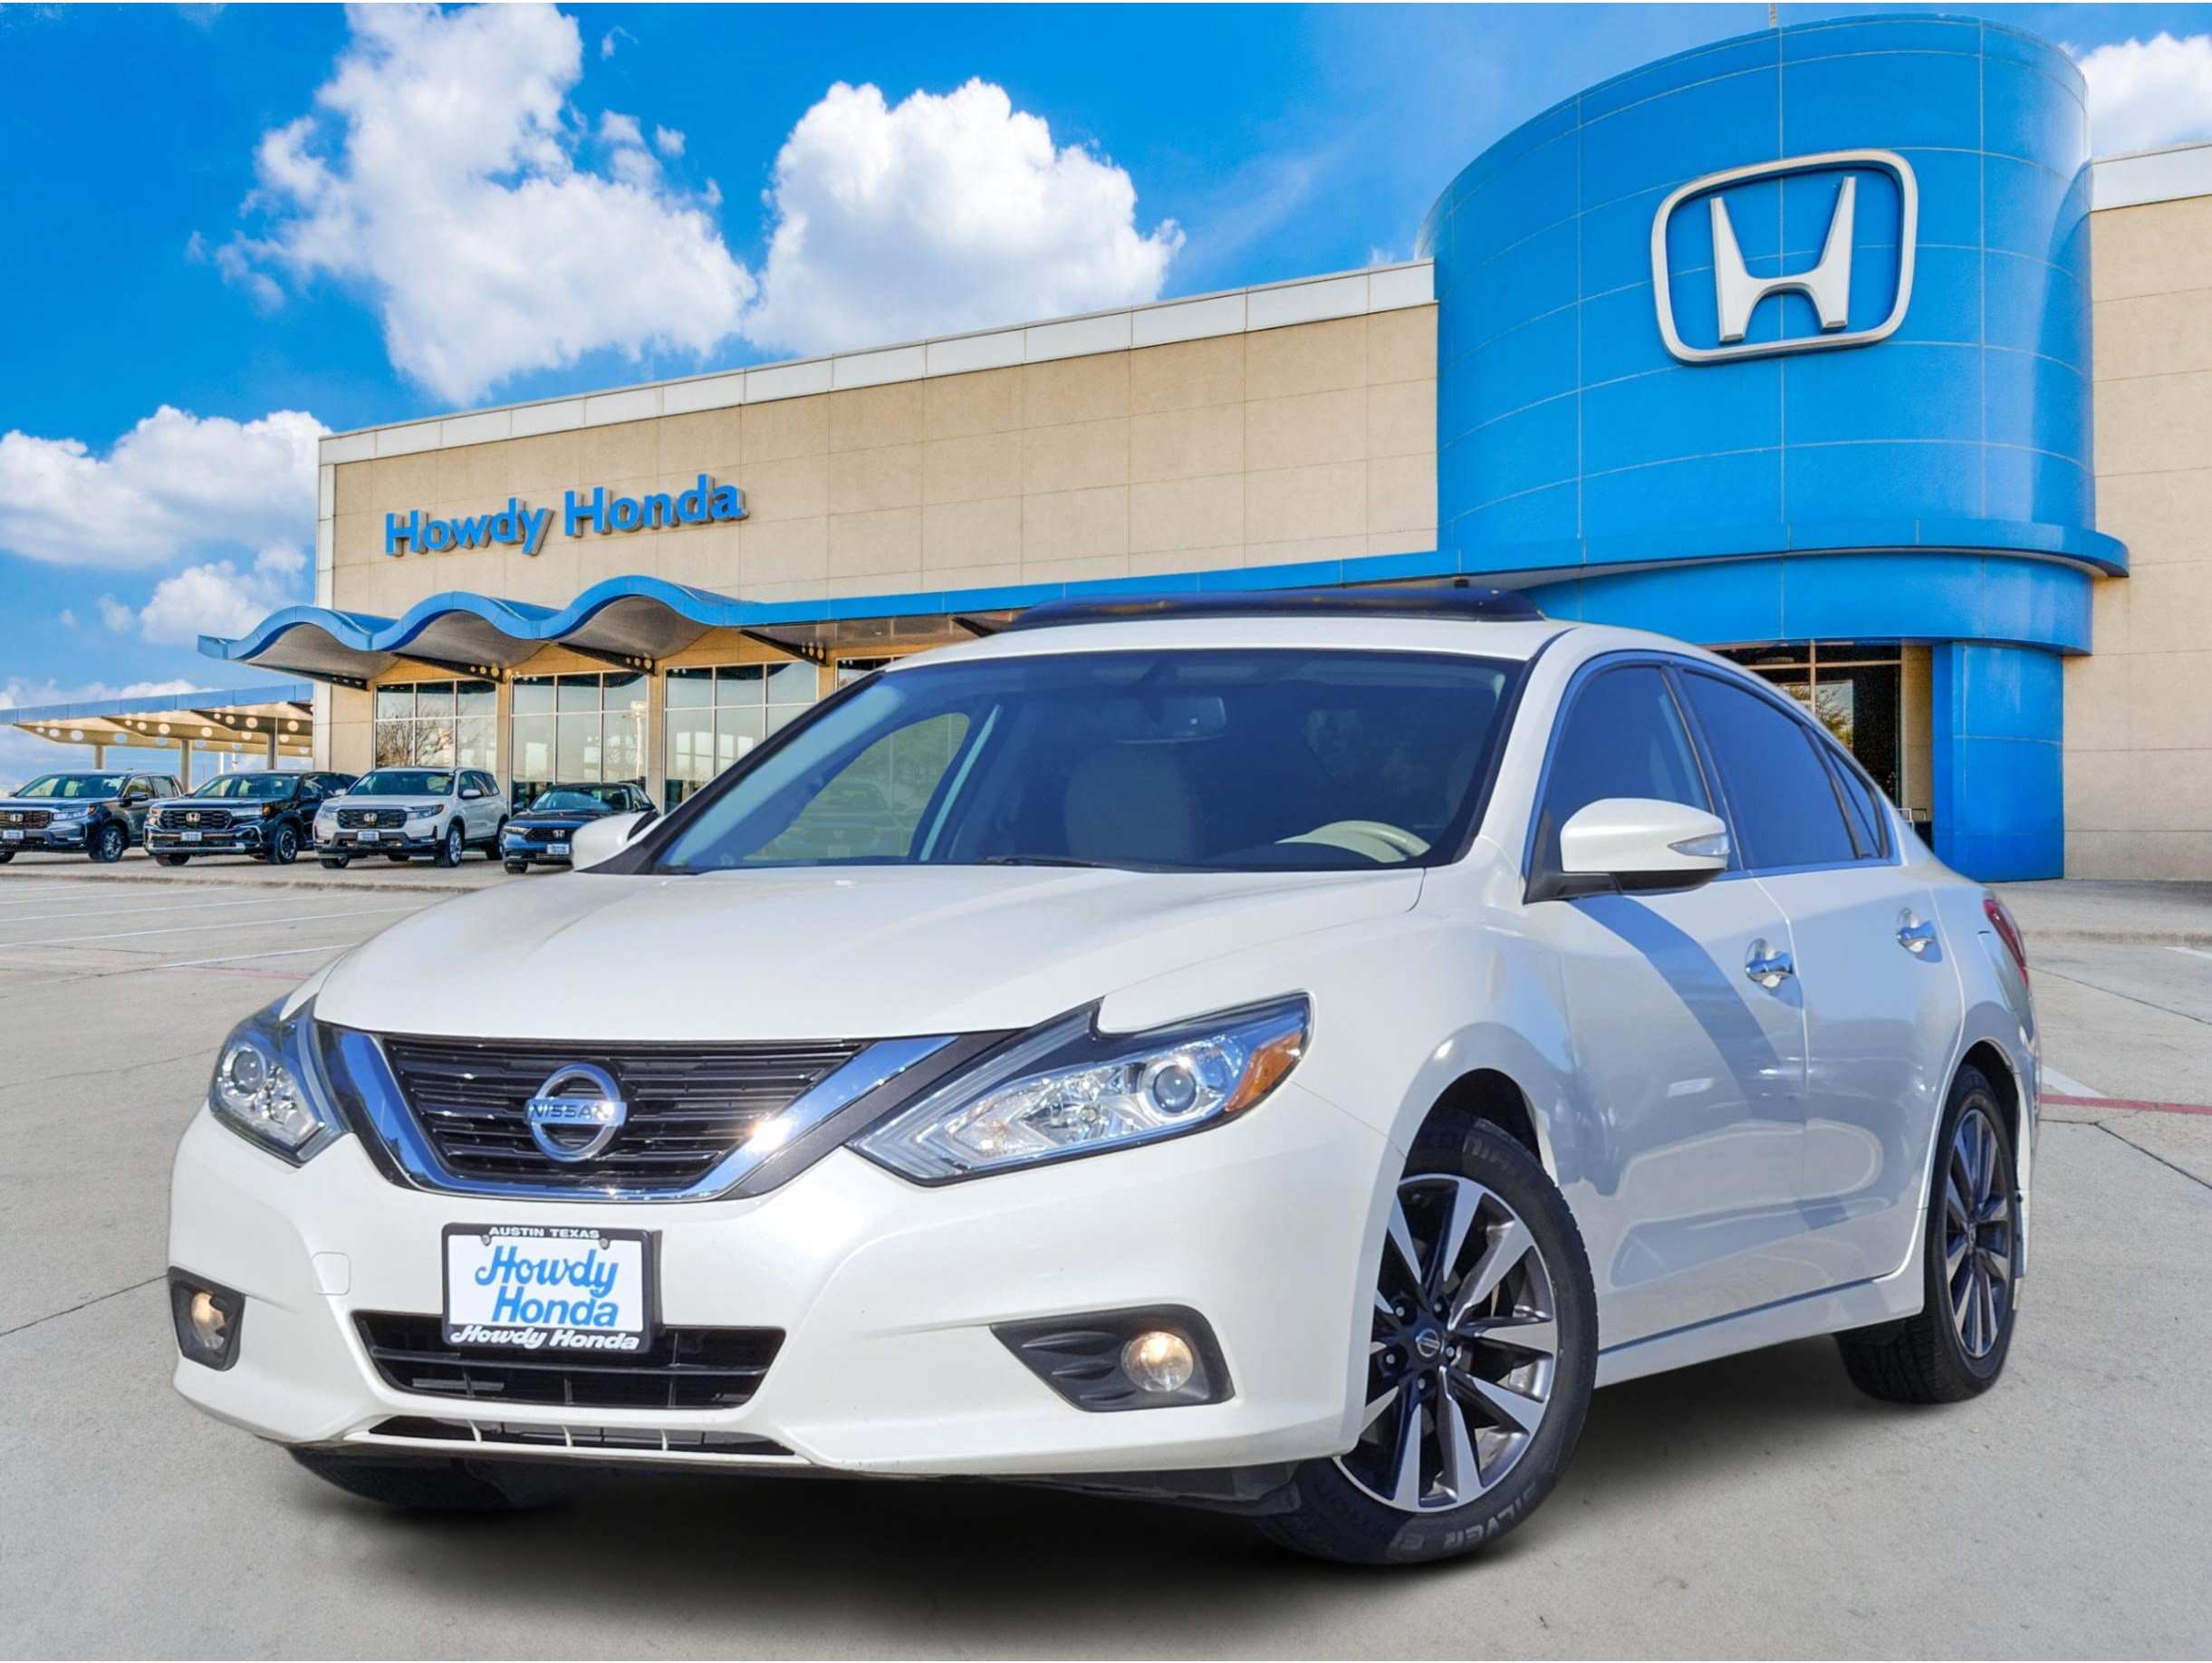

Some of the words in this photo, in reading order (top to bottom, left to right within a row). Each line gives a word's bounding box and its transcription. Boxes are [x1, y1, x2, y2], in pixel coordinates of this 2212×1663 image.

[385, 497, 553, 556] Howdy
[564, 474, 748, 538] Honda
[531, 1103, 611, 1120] NISSAN
[489, 1226, 544, 1237] AUSTIN
[550, 1228, 600, 1239] TEXAS
[475, 1245, 619, 1298] Howdy
[491, 1285, 620, 1328] Honda
[450, 1325, 547, 1349] Howdy
[549, 1329, 640, 1351] Honda
